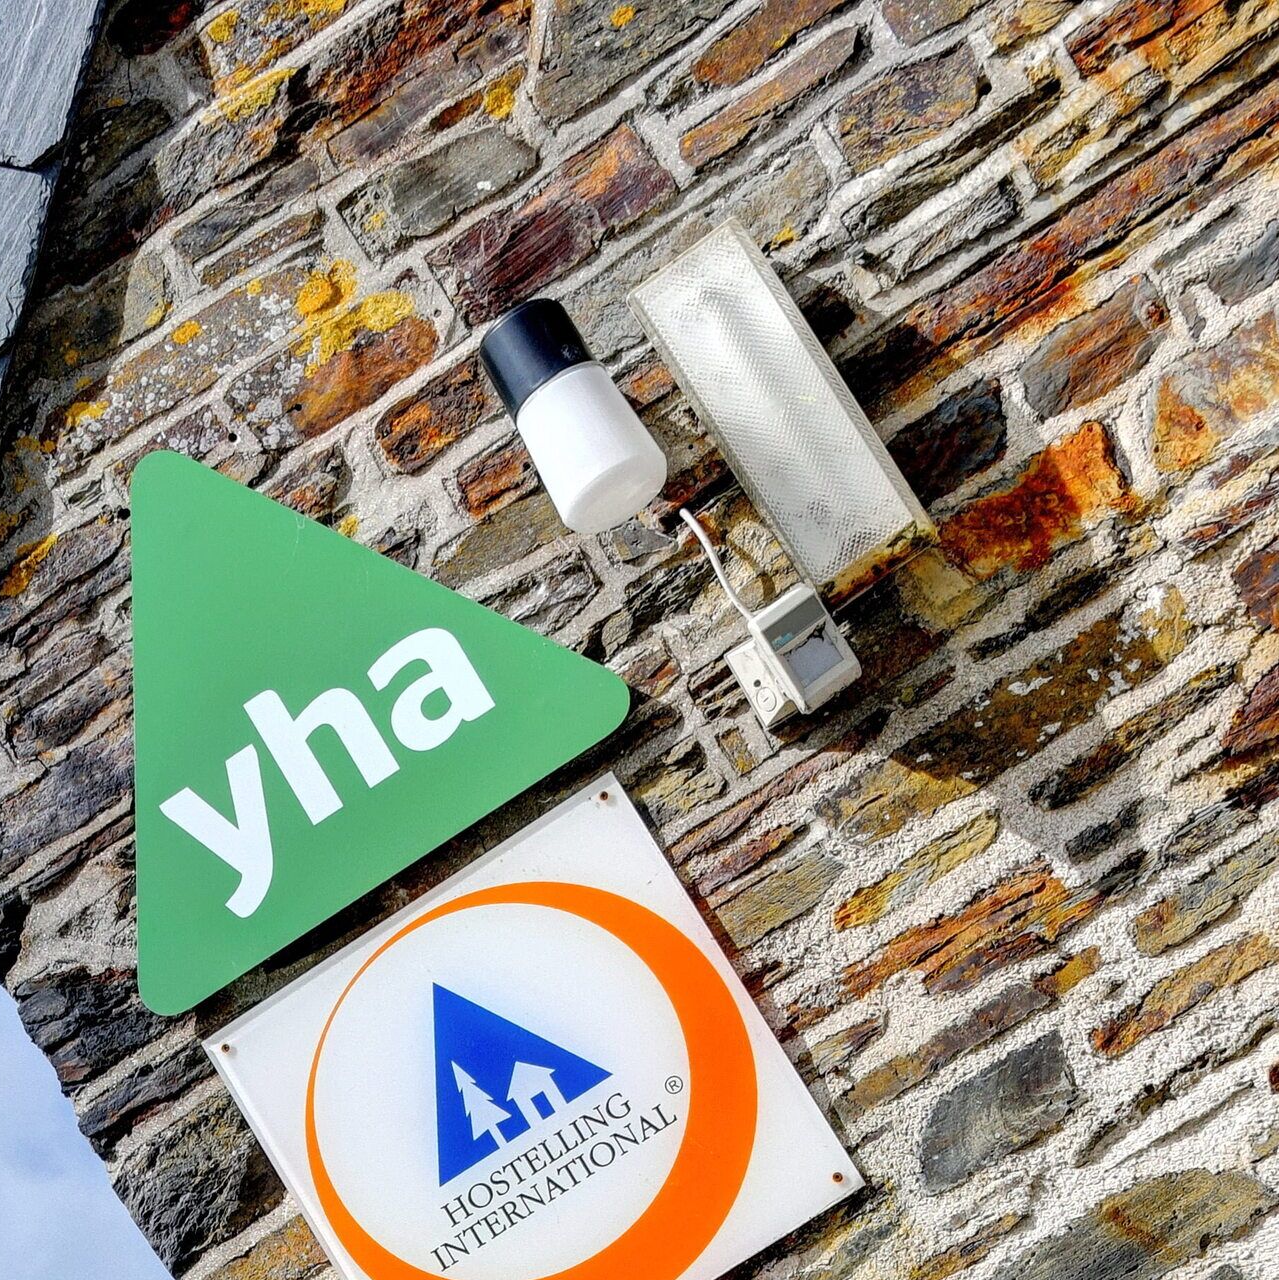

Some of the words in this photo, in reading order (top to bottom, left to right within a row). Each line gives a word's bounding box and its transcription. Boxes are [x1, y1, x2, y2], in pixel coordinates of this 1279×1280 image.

[158, 627, 496, 919] yha
[430, 1104, 677, 1272] INTERNATIONAL
[440, 1092, 632, 1228] HOSTELLING
